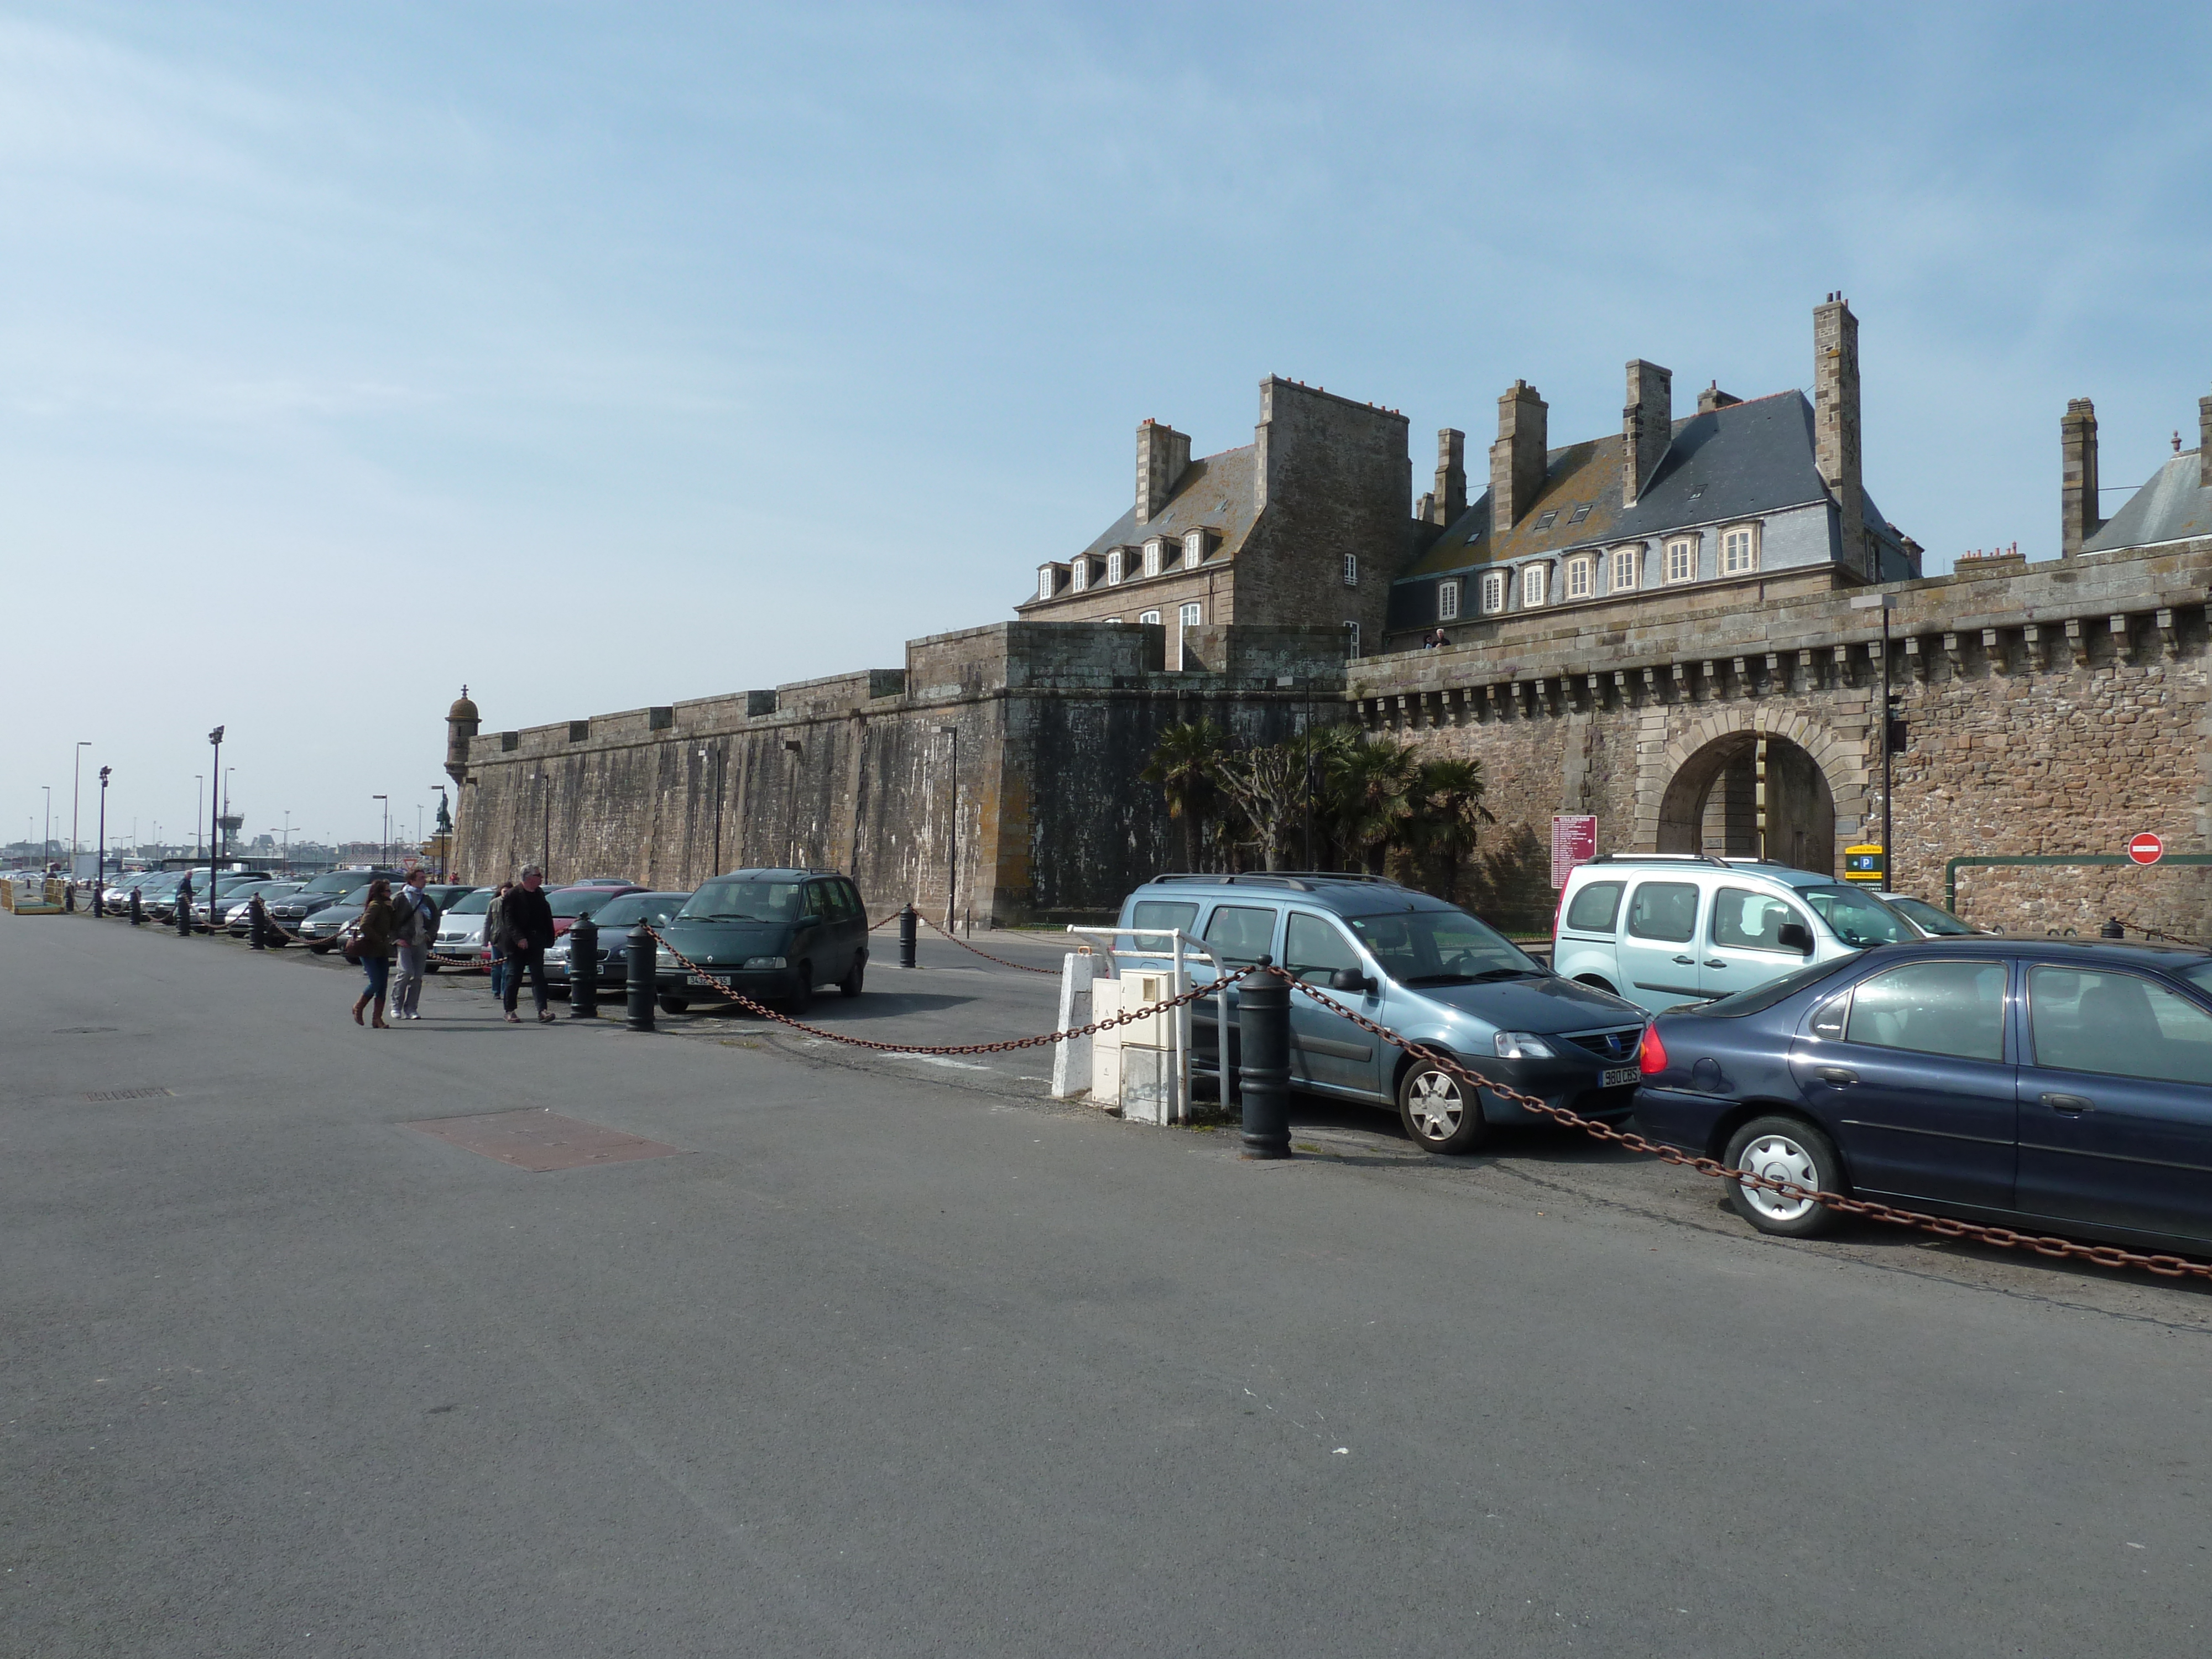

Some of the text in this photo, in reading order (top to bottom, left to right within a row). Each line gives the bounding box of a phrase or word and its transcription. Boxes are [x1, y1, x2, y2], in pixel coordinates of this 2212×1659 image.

[1863, 858, 1870, 868] P
[1605, 1070, 1621, 1085] 980
[1623, 1067, 1637, 1082] CBS
